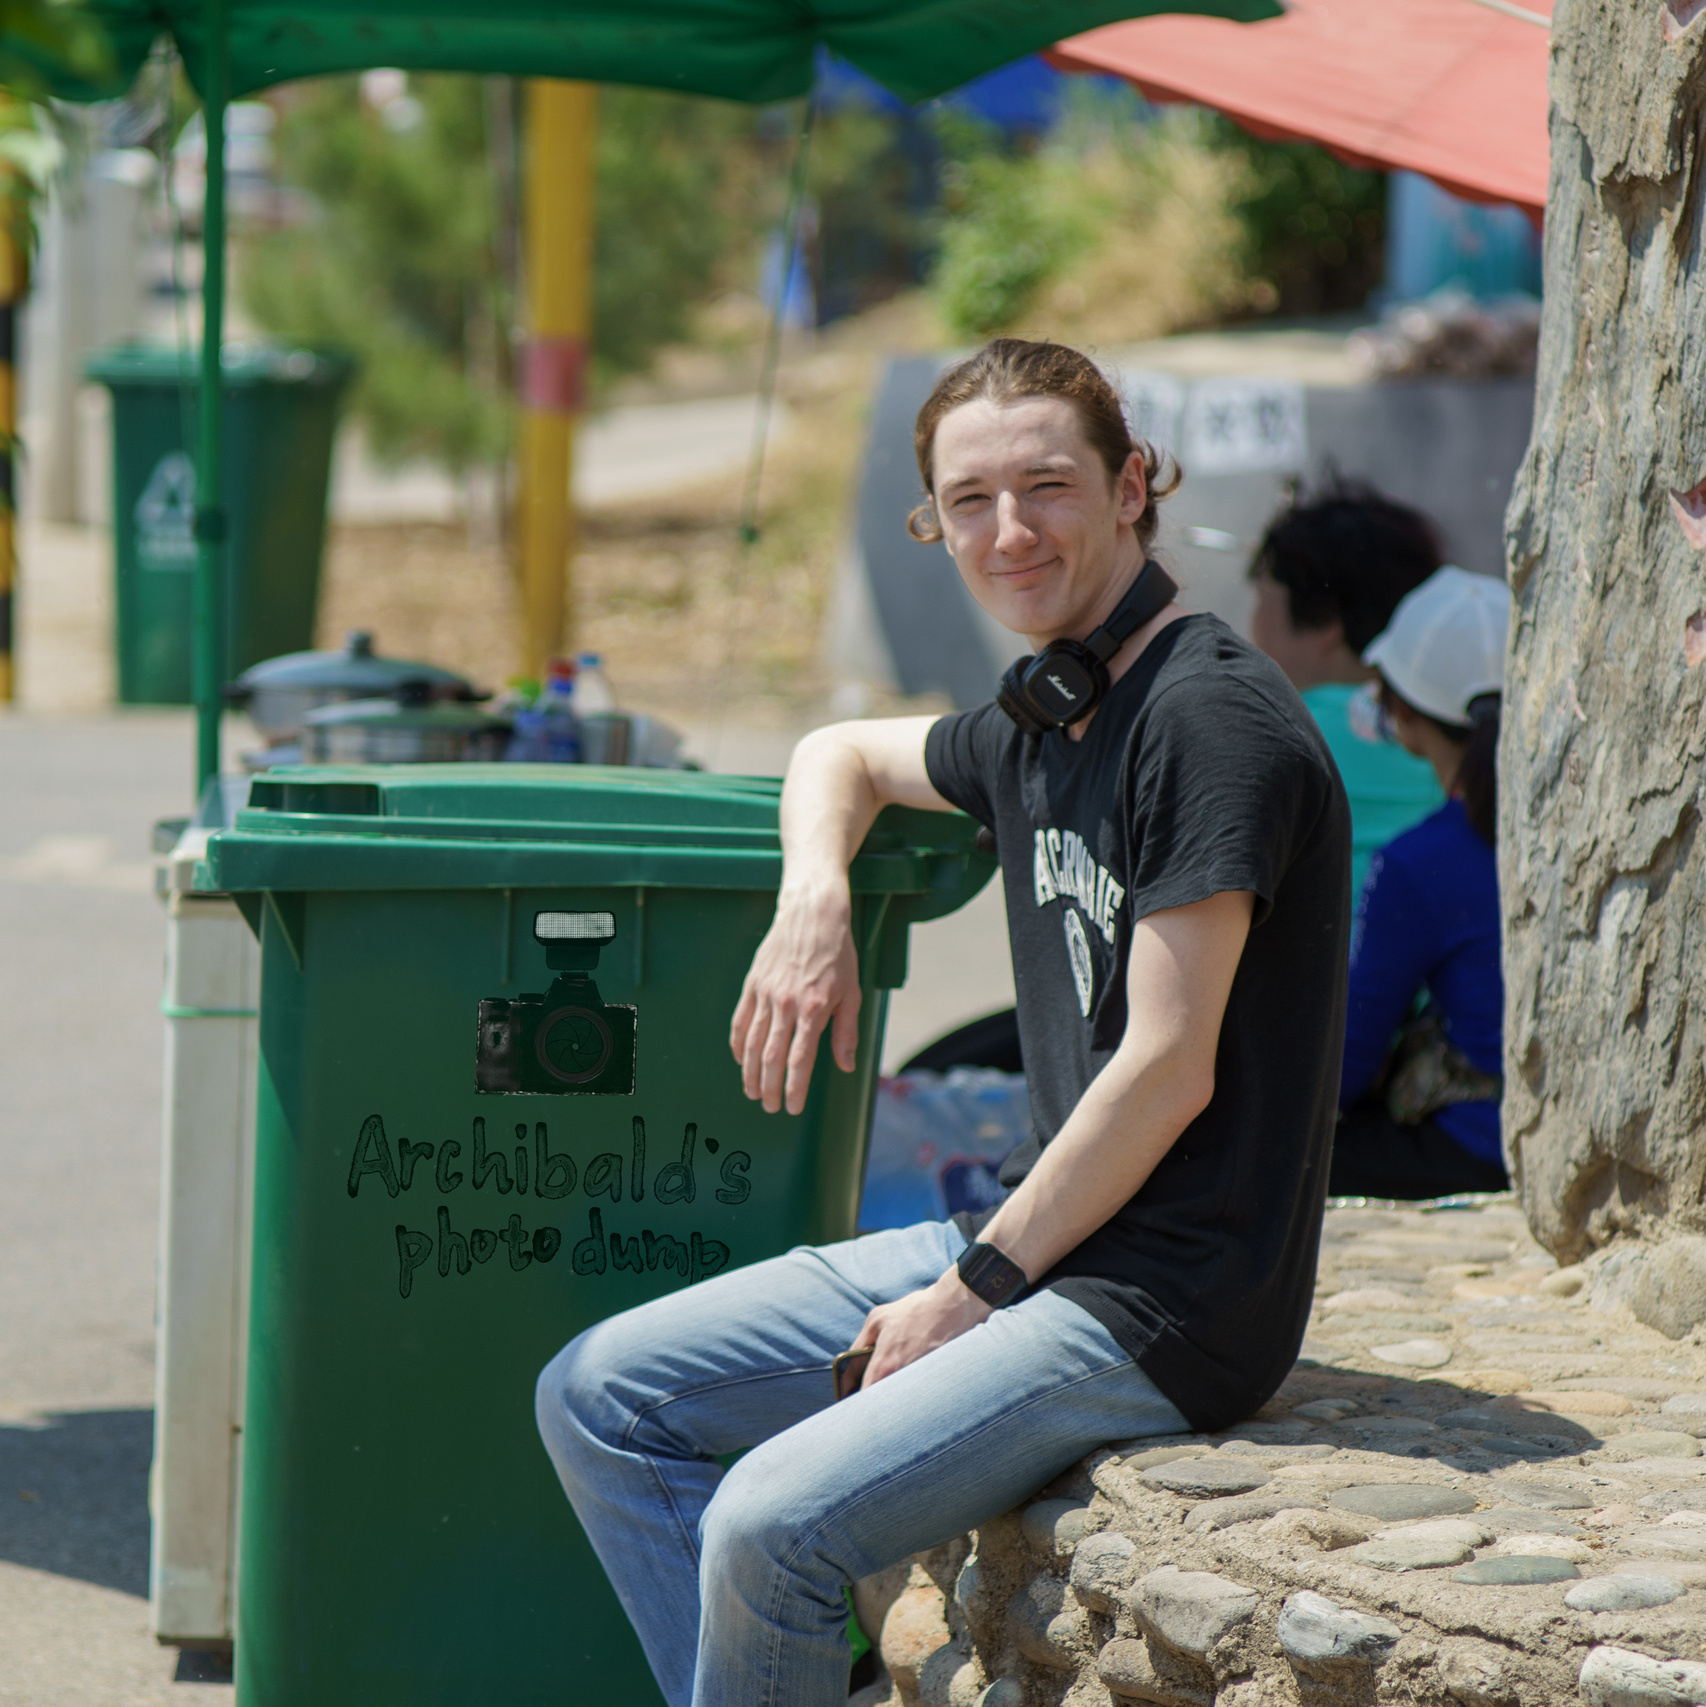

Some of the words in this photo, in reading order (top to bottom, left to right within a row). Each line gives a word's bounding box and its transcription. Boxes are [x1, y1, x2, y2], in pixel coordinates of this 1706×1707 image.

[347, 1114, 752, 1205] Archibald's
[395, 1205, 562, 1299] photo
[572, 1206, 731, 1285] dump
